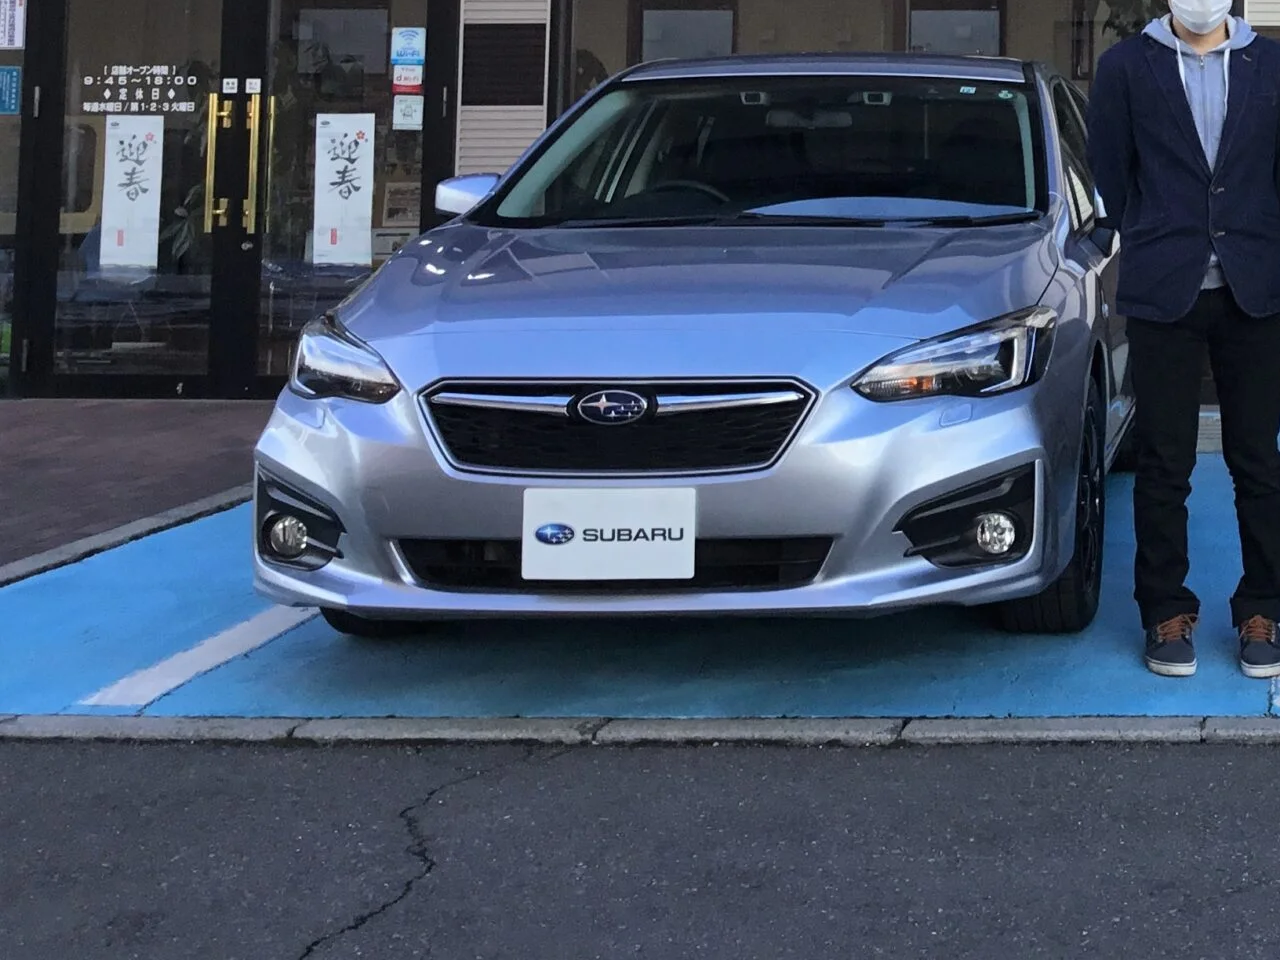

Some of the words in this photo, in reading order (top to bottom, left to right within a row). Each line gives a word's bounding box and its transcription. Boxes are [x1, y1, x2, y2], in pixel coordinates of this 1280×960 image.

[117, 134, 150, 202] 迎春
[328, 132, 362, 200] 迎春
[582, 528, 684, 542] SUBARU
